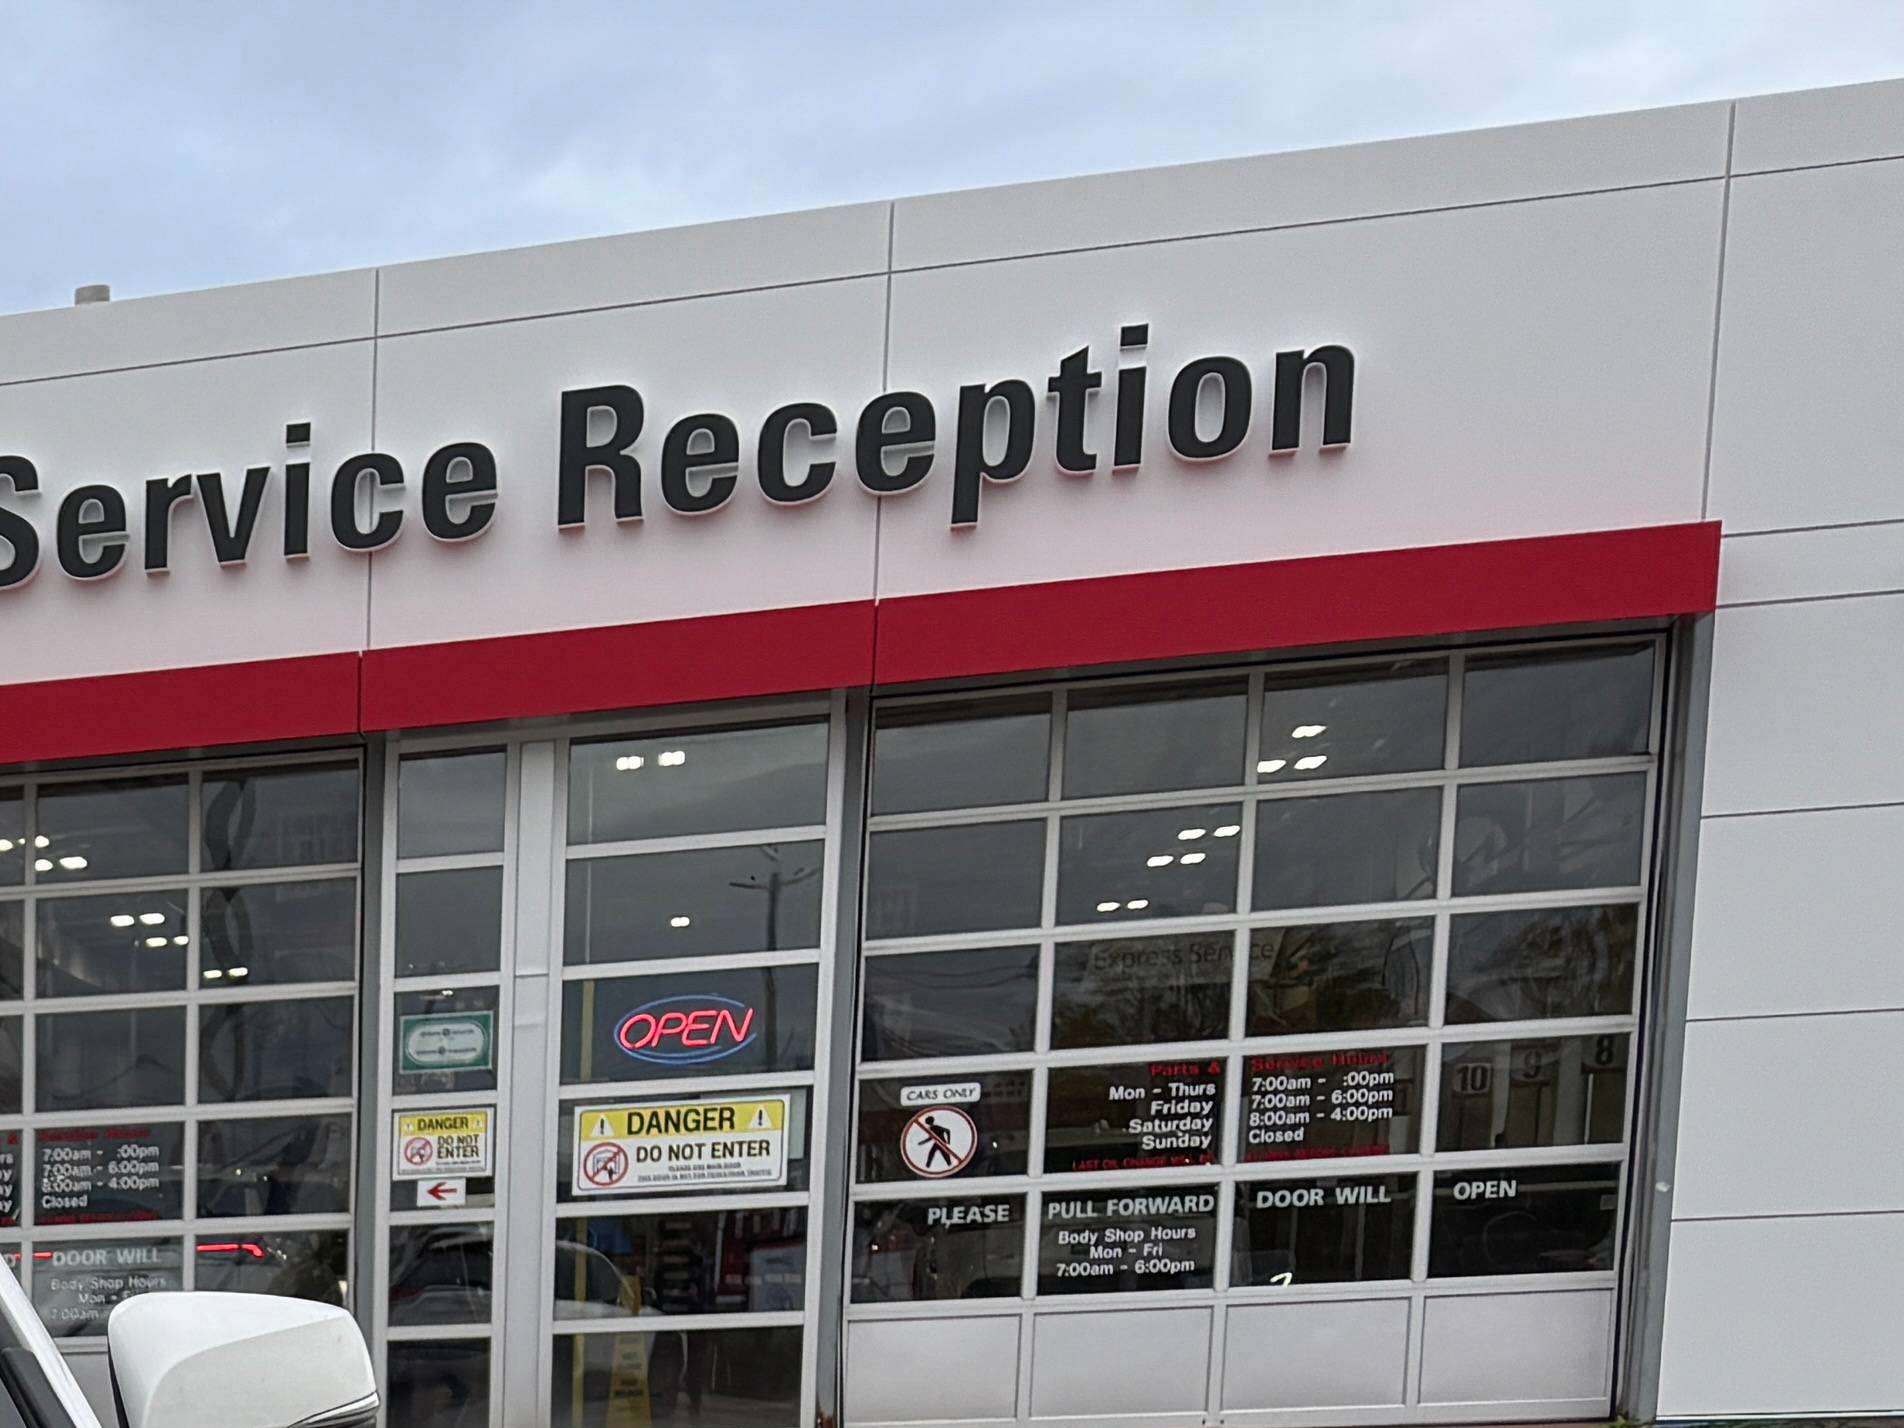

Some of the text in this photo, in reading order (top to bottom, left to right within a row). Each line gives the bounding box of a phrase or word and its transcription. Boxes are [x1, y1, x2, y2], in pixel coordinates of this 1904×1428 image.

[557, 323, 1355, 529] Reception
[1191, 941, 1274, 964] Serce
[619, 1008, 755, 1049] OPEN
[1595, 1034, 1615, 1066] 8
[1109, 1086, 1145, 1100] Mon
[1168, 1082, 1216, 1097] Thurs
[1252, 1076, 1311, 1092] 7:00am
[1455, 1064, 1489, 1092] 10
[906, 1087, 977, 1101] CARS ONLY
[1150, 1100, 1213, 1115] Friday
[1251, 1093, 1310, 1109] 7:00am
[1331, 1089, 1393, 1105] 6:00pm
[417, 1116, 469, 1131] DANGER
[627, 1106, 736, 1136] DANGER
[1128, 1117, 1213, 1134] Saturday
[1249, 1111, 1310, 1127] 8:00am
[1330, 1106, 1393, 1122] 4:00pm
[437, 1134, 480, 1146] DO NOT
[1142, 1127, 1304, 1150] Sunday Closed
[437, 1145, 479, 1159] ENTER
[636, 1139, 771, 1163] DO NOT ENTER
[108, 1160, 159, 1175] 6:00pm
[108, 1176, 159, 1191] 4:00pm
[42, 1194, 88, 1209] Closed
[927, 1180, 1517, 1225] PLEASE PULL FORWARD DOOR WILL OPEN
[1058, 1226, 1197, 1245] Body Shop Hours
[52, 1248, 162, 1267] DOOR WILL
[1089, 1246, 1122, 1259] Mon
[1143, 1243, 1163, 1256] Fri
[1056, 1263, 1114, 1277] 7:00am
[1135, 1259, 1195, 1274] 6:00pm
